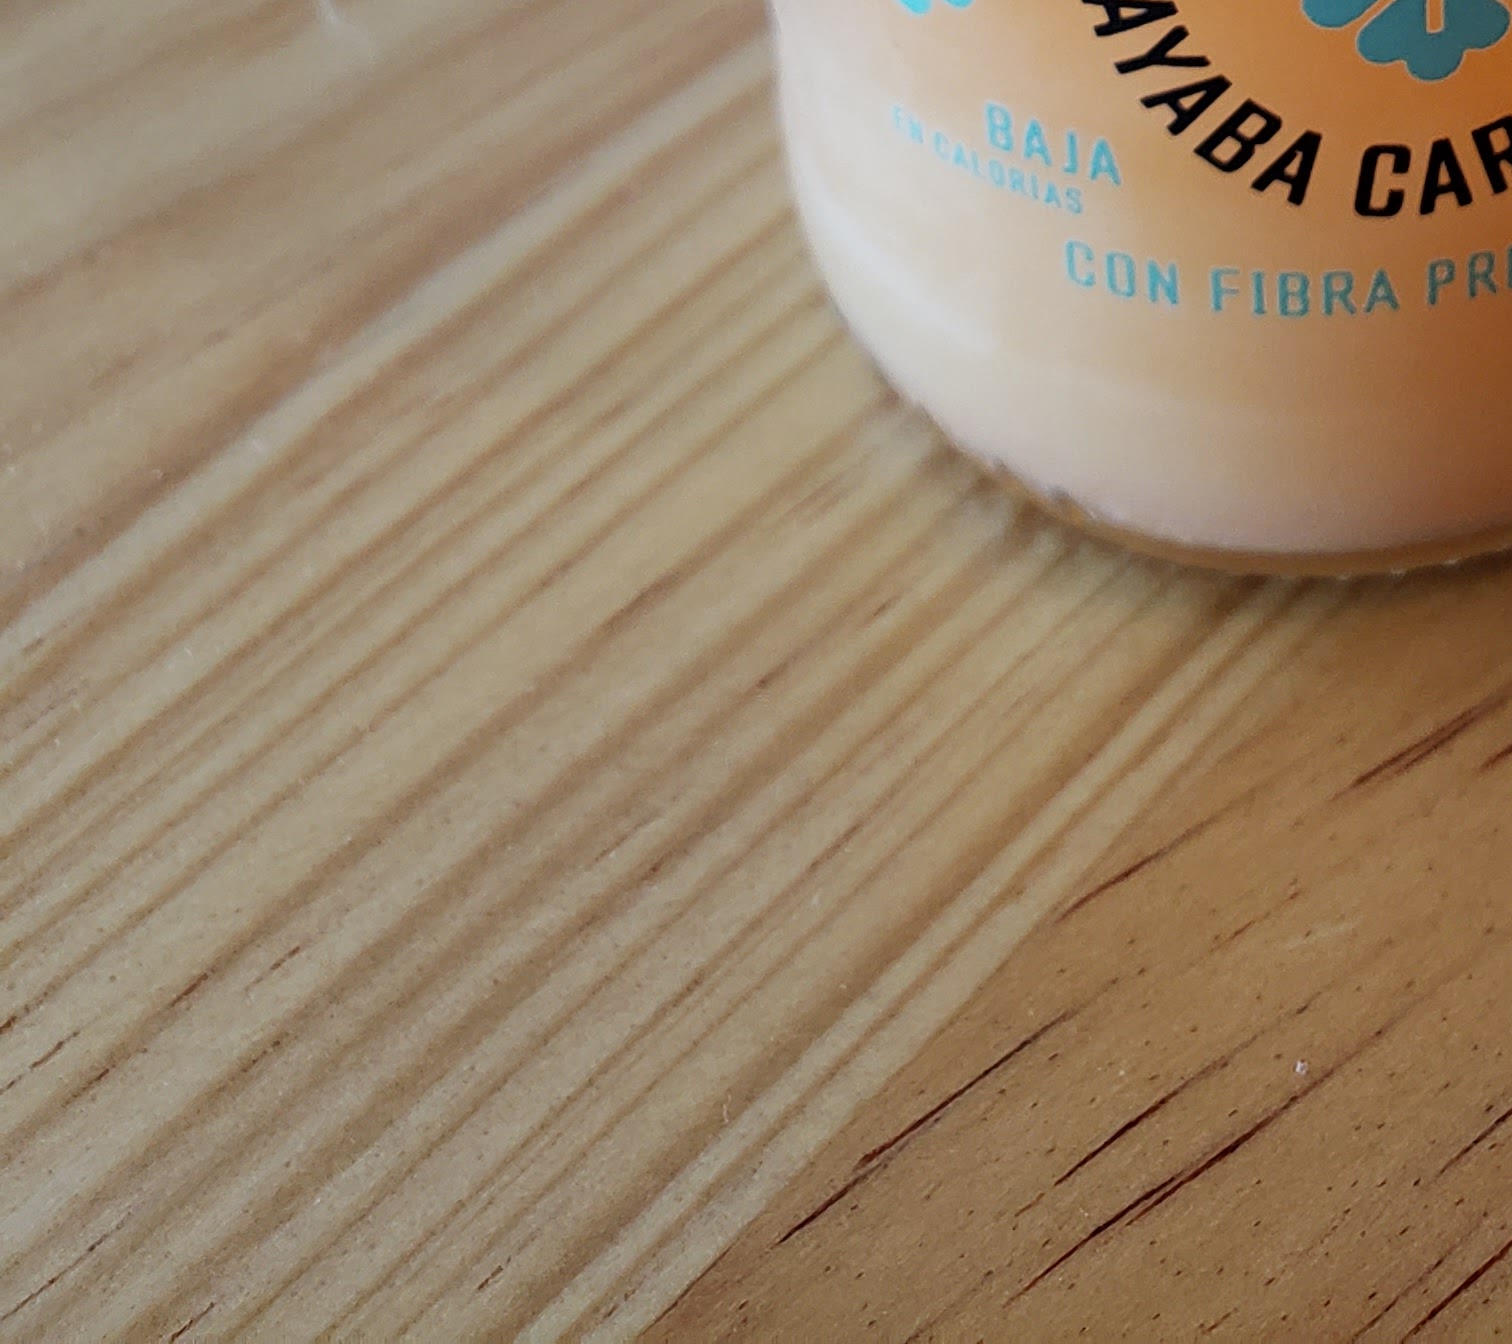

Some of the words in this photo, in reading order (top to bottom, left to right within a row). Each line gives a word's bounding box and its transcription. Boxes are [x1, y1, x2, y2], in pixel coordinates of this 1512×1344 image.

[984, 100, 1122, 188] BAJA
[1064, 239, 1181, 307] CON
[1208, 265, 1401, 318] FIBRA
